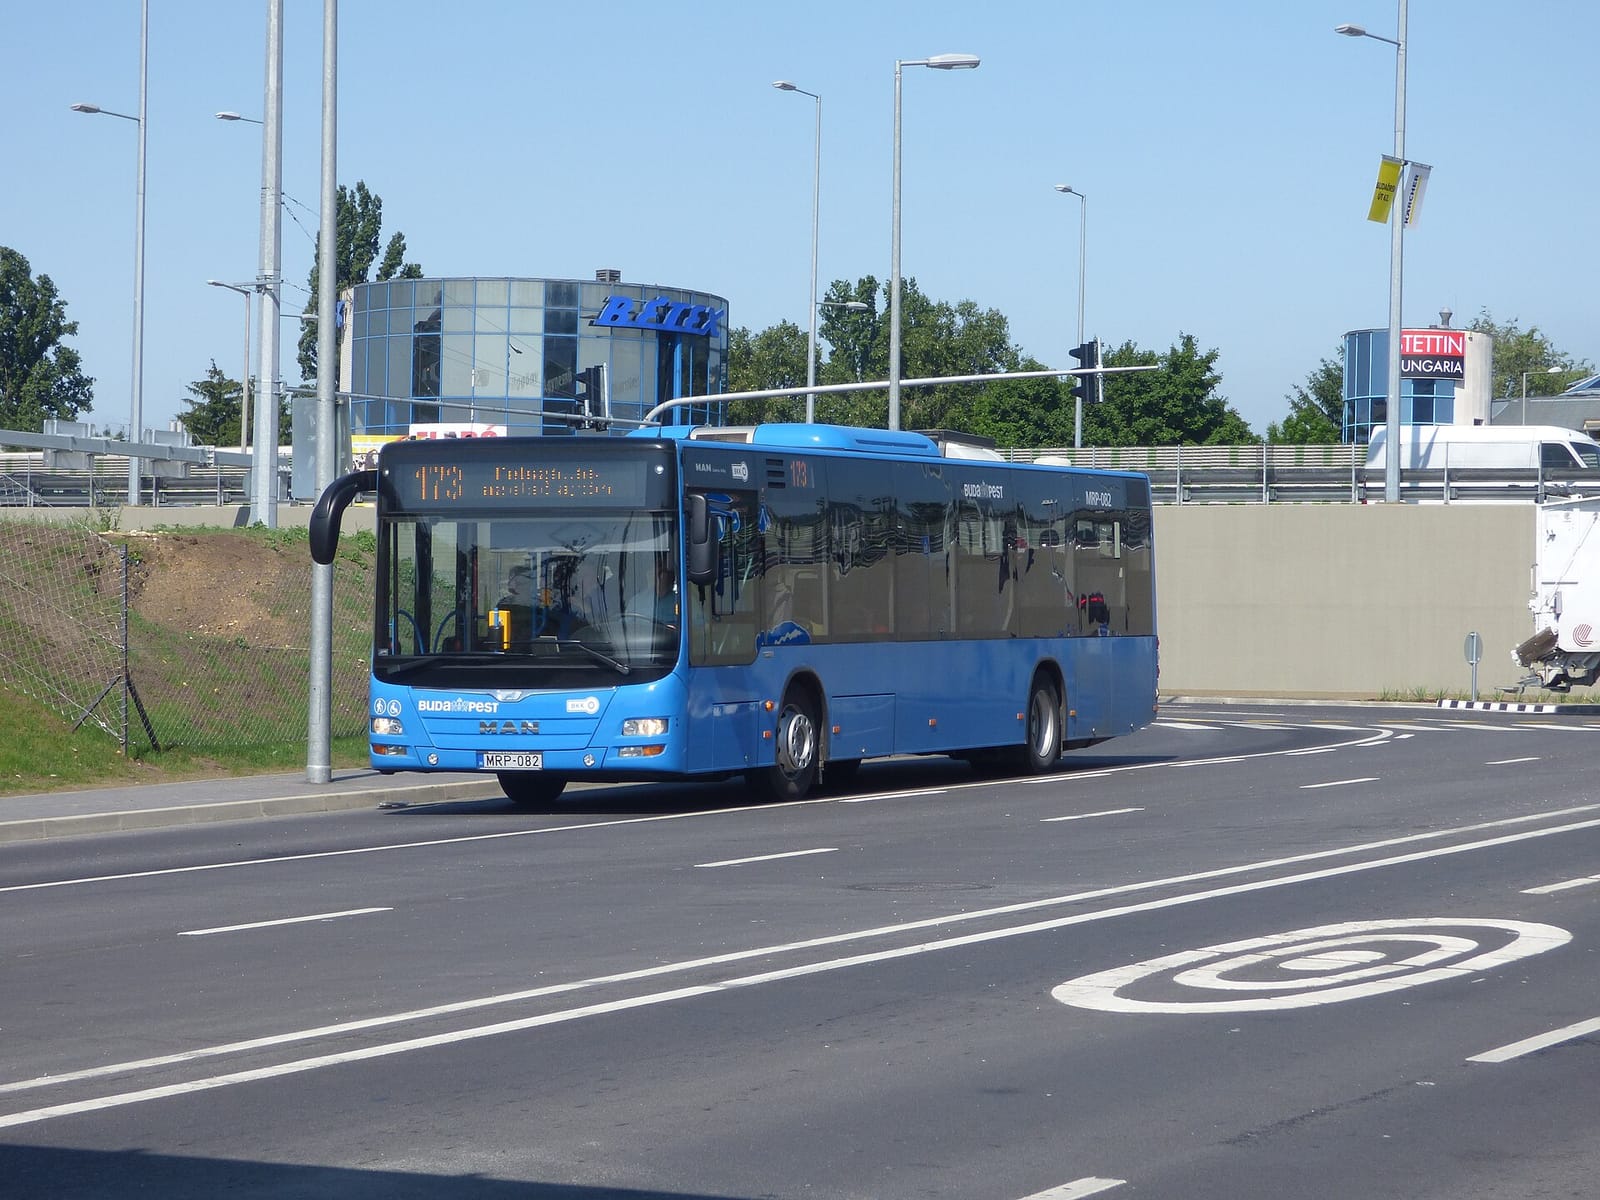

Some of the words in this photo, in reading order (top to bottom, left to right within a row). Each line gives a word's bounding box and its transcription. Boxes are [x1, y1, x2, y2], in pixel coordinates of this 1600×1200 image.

[1400, 335, 1463, 353] TETTIN
[1401, 360, 1463, 373] UNGARIA
[695, 463, 711, 472] MAN
[790, 461, 807, 488] 173
[415, 466, 462, 500] 173
[1085, 491, 1112, 507] MRP-082
[479, 721, 540, 735] MAN
[486, 755, 539, 767] MRP-082
